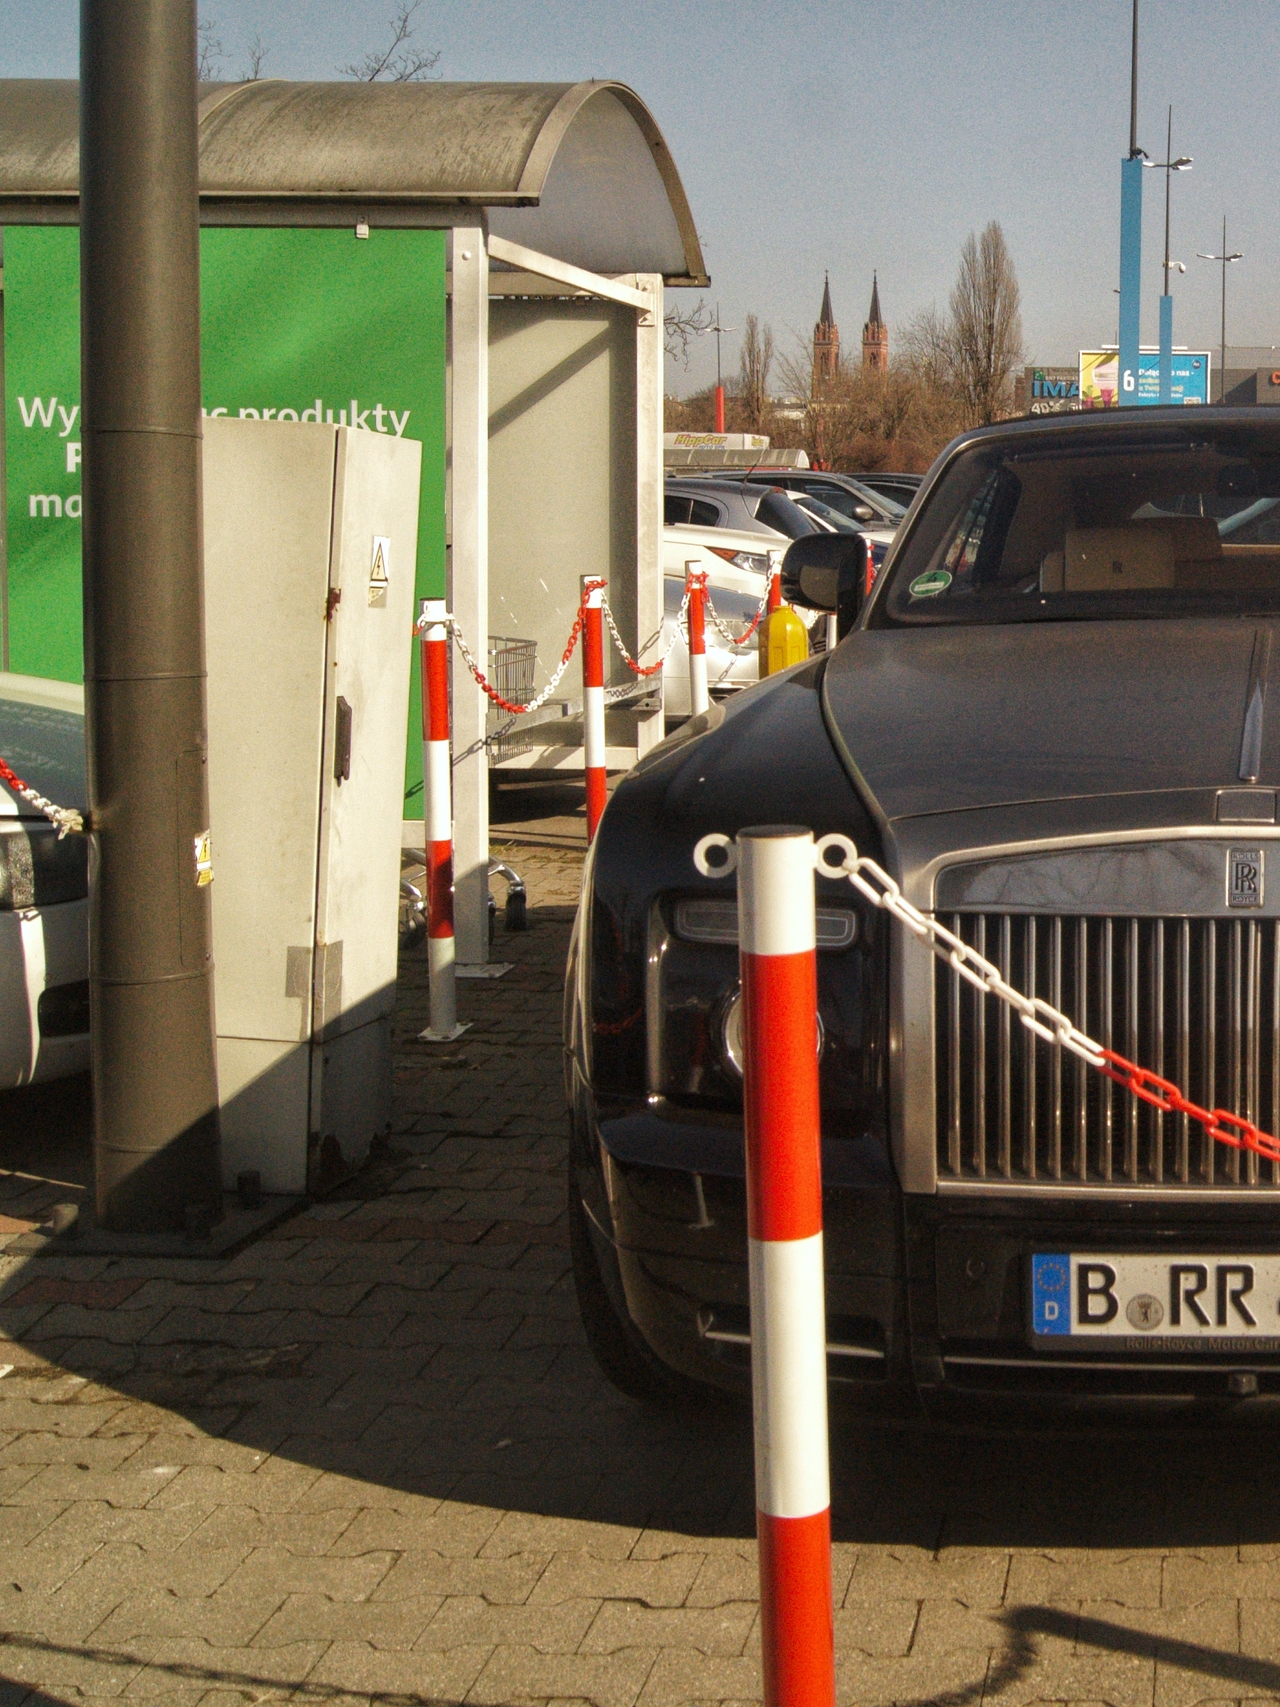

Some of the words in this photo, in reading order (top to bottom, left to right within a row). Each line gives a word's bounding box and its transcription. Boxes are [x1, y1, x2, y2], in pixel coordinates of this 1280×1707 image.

[1123, 369, 1135, 391] 6
[1233, 852, 1259, 860] ROLLS
[1233, 895, 1258, 903] ROYCE
[1045, 1301, 1059, 1321] D
[1077, 1263, 1119, 1325] B
[1168, 1264, 1258, 1327] RR
